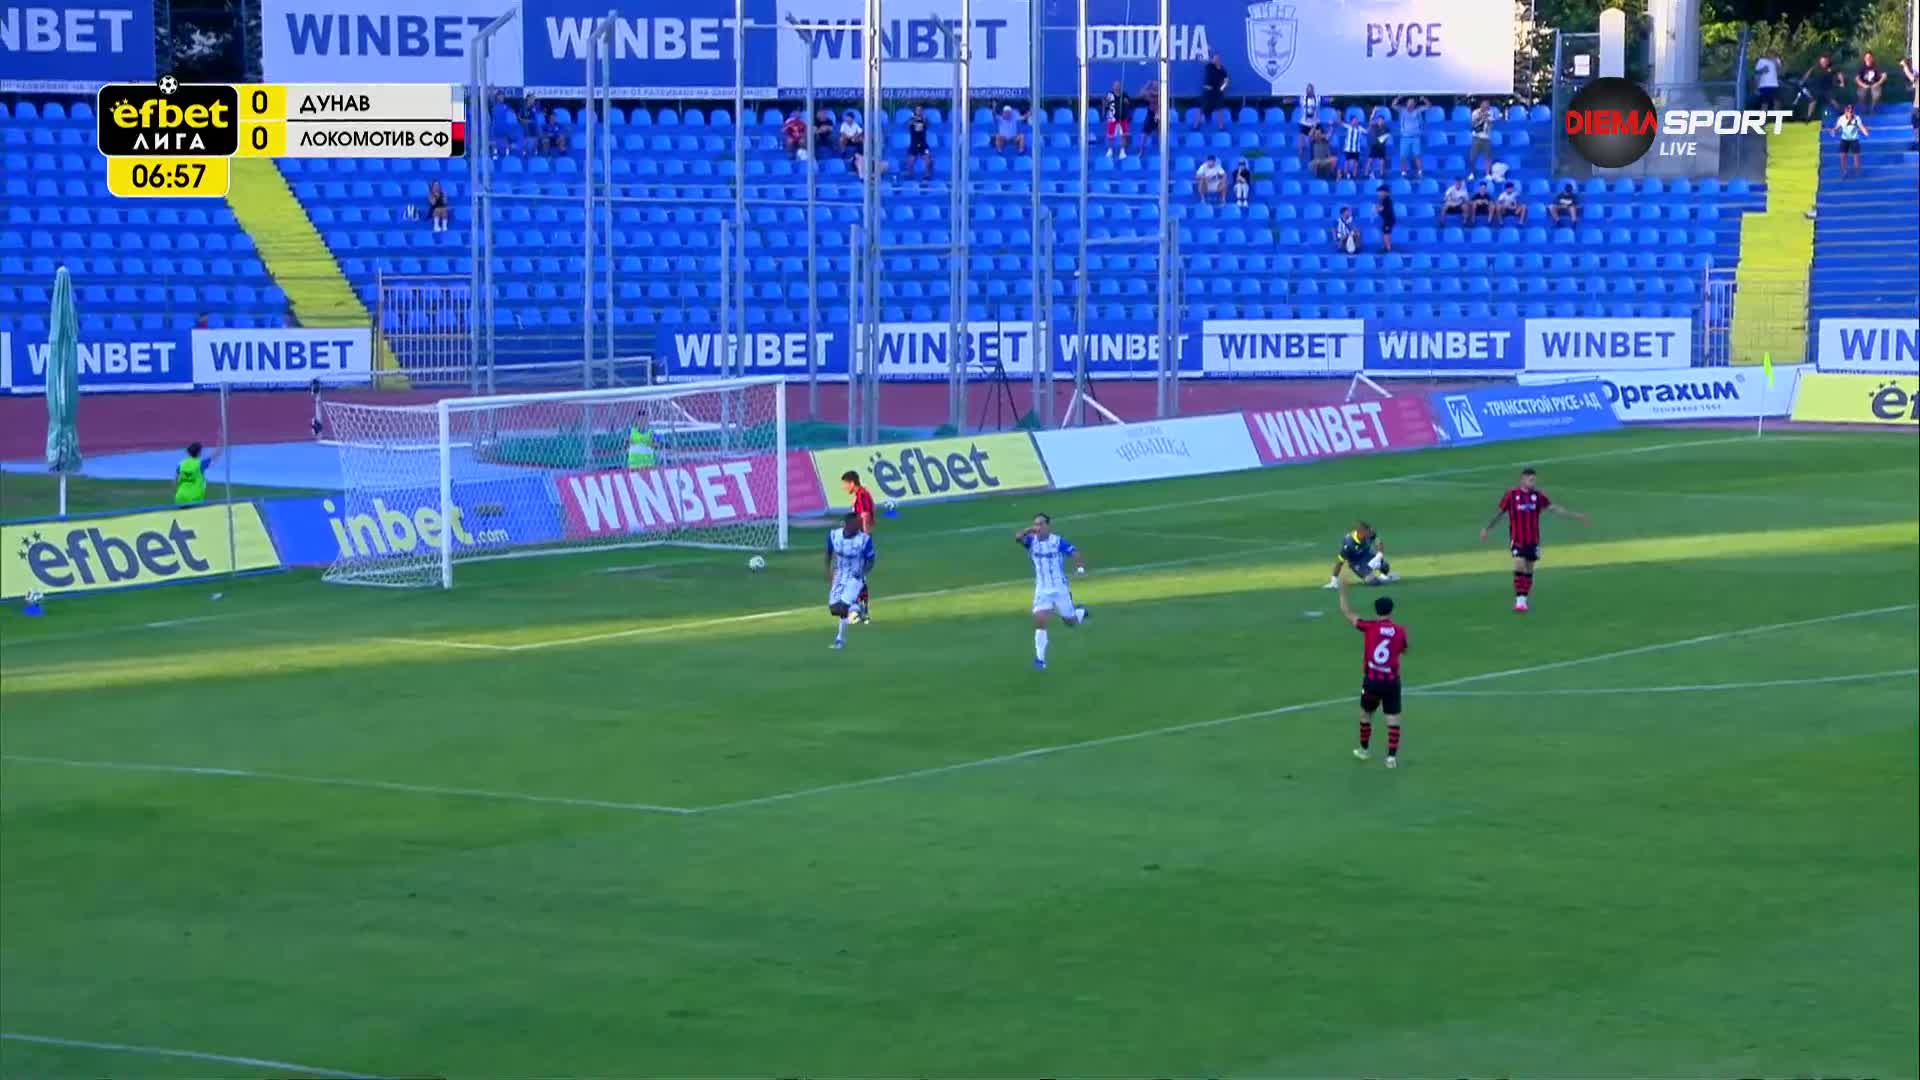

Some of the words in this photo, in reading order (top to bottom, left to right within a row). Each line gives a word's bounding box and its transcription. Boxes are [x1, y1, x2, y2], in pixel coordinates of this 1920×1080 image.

[286, 13, 496, 56] WINBET
[1367, 23, 1441, 57] РУСЕ
[28, 343, 176, 375] WNBET
[209, 340, 354, 371] WINBET
[878, 331, 1027, 364] WINBET
[1220, 333, 1348, 359] WINBET
[1378, 331, 1511, 359] WINBET
[1542, 331, 1676, 358] WINBET
[1256, 402, 1389, 459] WINBET
[871, 443, 1000, 499] efbet
[569, 461, 760, 532] WINBET
[27, 519, 210, 588] efbet
[1374, 639, 1390, 664] 6
